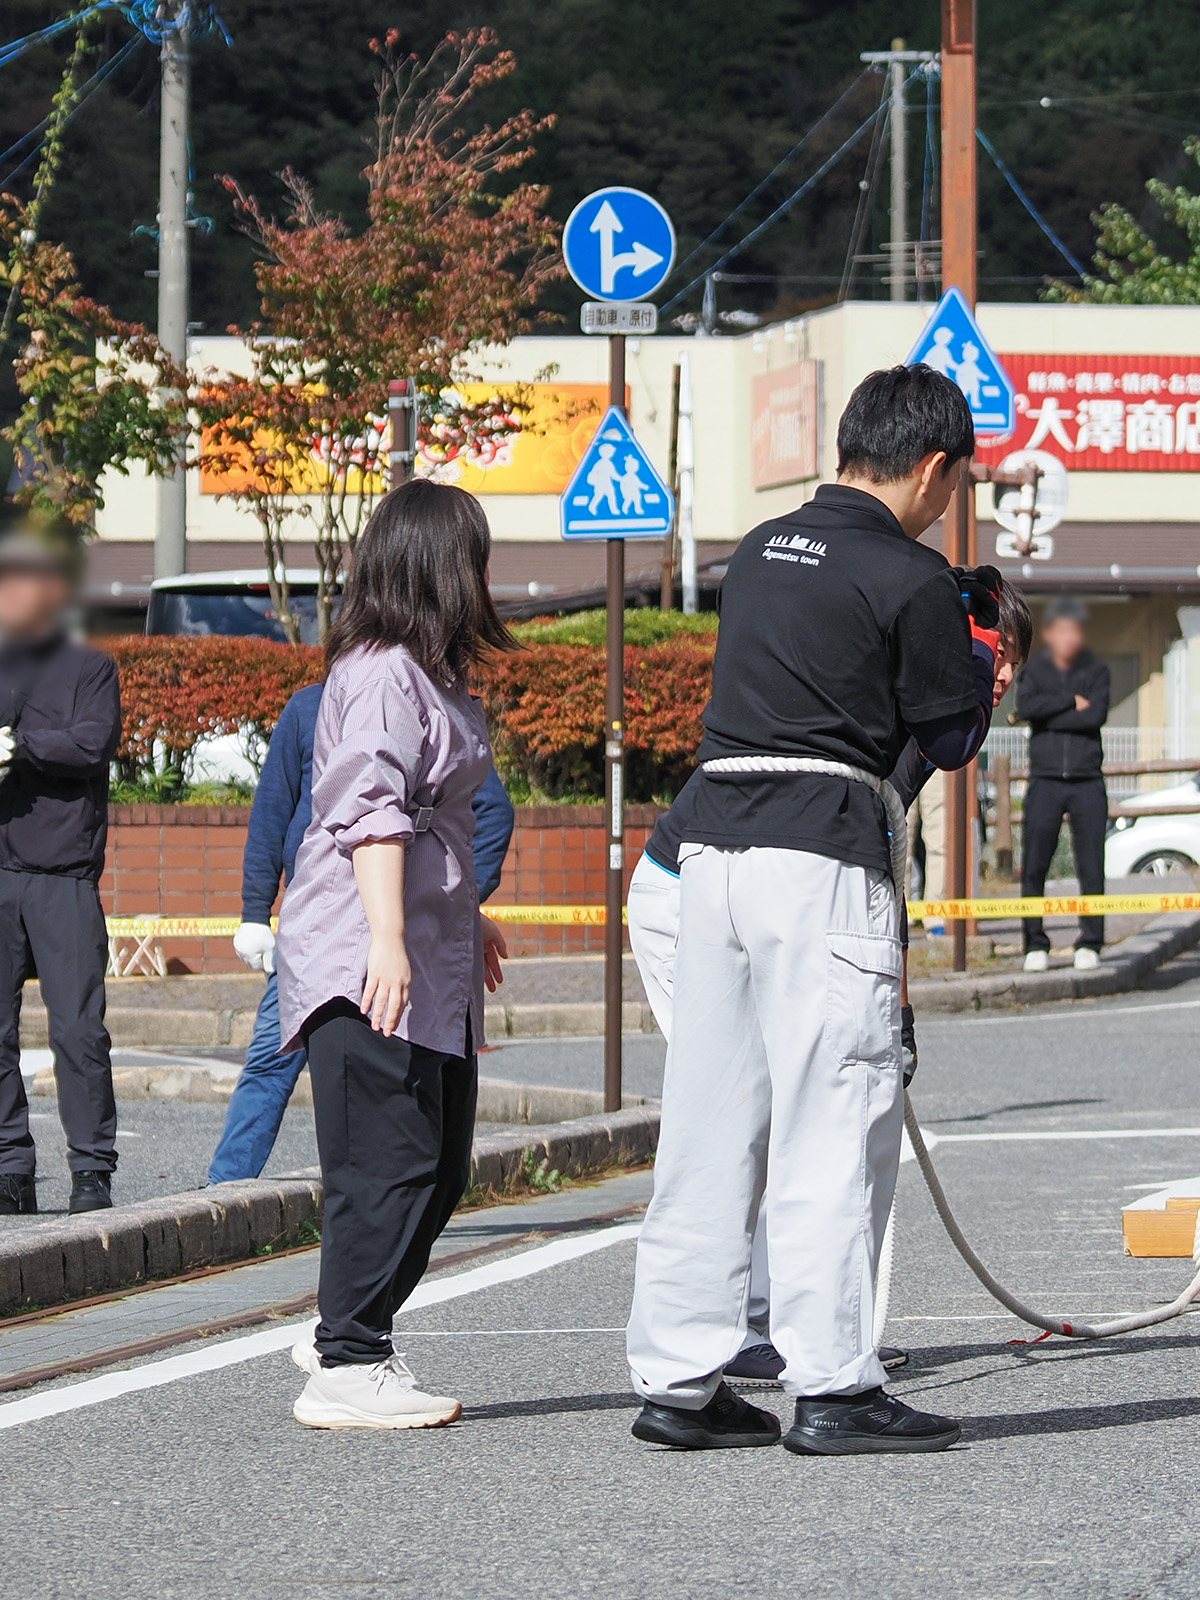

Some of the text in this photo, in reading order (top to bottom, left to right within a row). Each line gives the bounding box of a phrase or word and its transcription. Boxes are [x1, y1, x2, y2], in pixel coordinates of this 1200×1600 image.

[585, 308, 653, 326] 自動車・原付
[762, 548, 820, 567] Agematsu town
